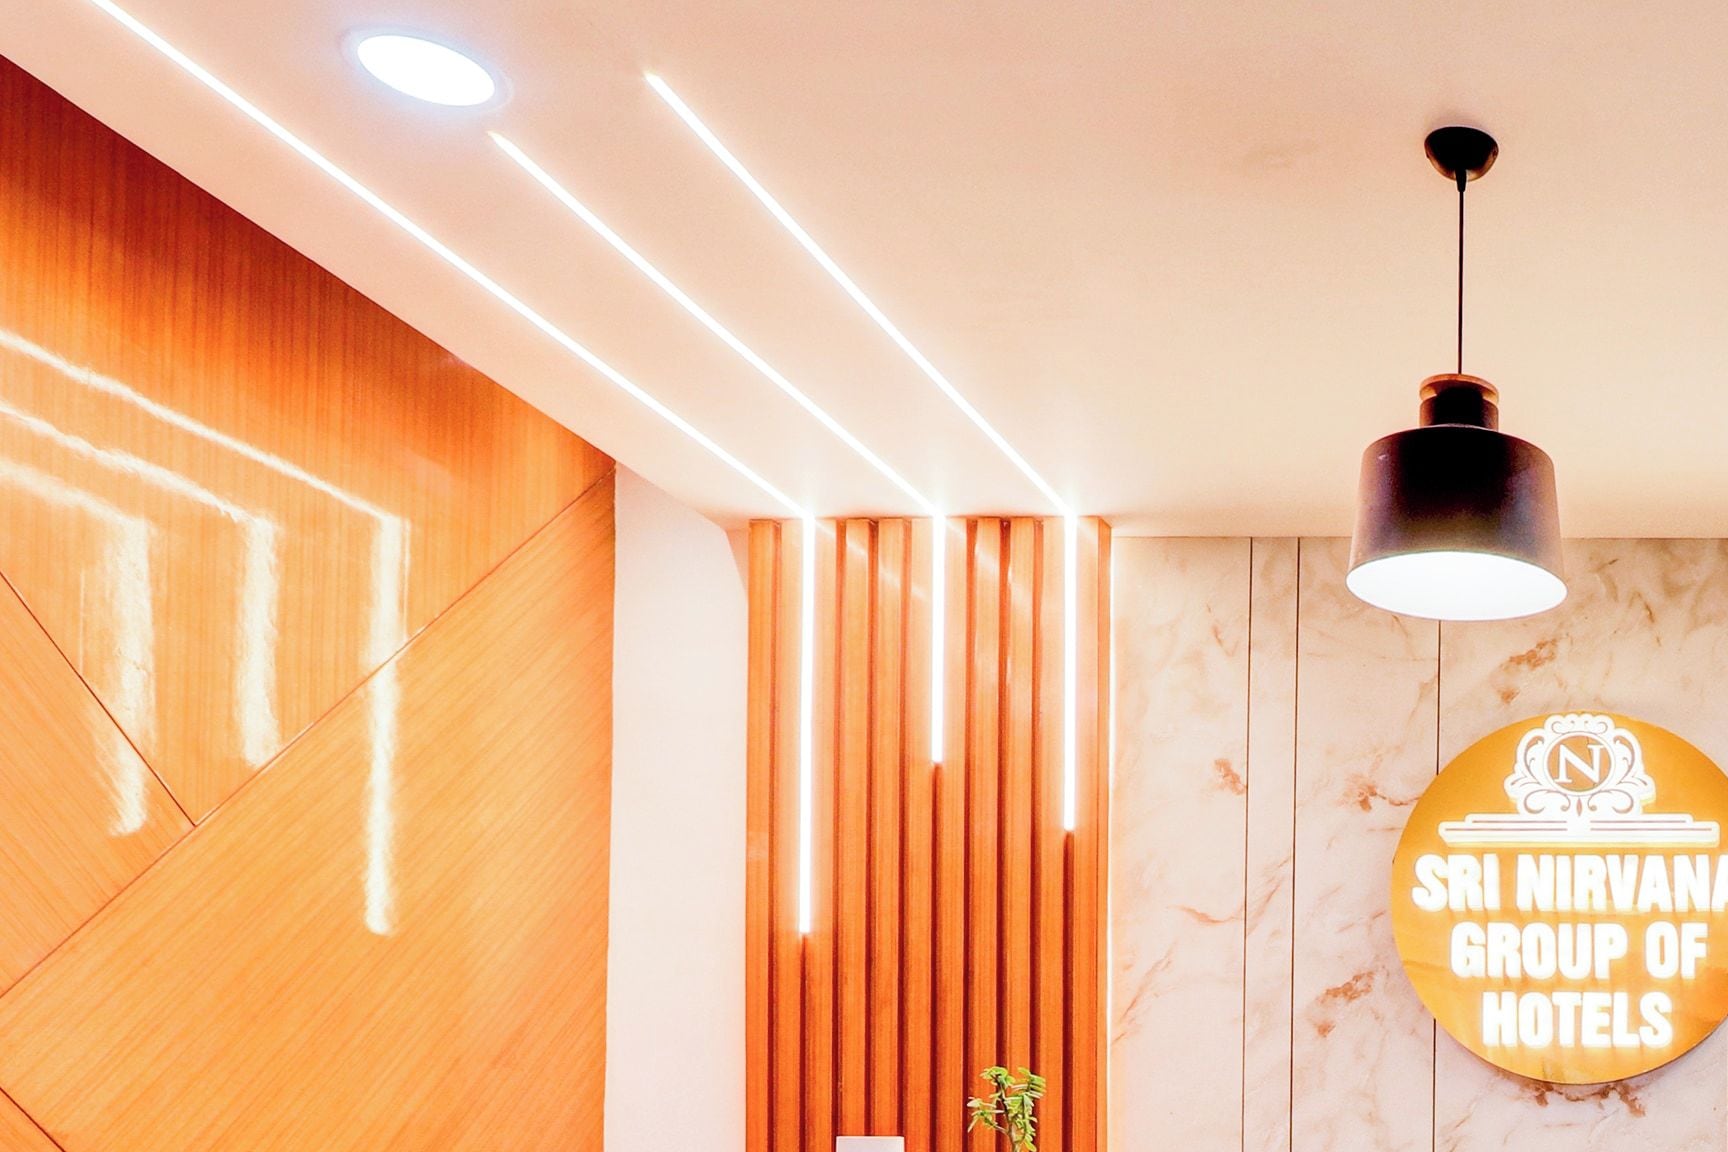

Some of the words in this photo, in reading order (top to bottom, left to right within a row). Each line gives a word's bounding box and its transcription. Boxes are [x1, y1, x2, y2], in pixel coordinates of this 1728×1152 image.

[1555, 745, 1604, 784] N
[1412, 853, 1500, 913] SRI
[1450, 921, 1629, 981] GROUP
[1645, 921, 1709, 981] OF
[1481, 990, 1674, 1049] HOTELS
